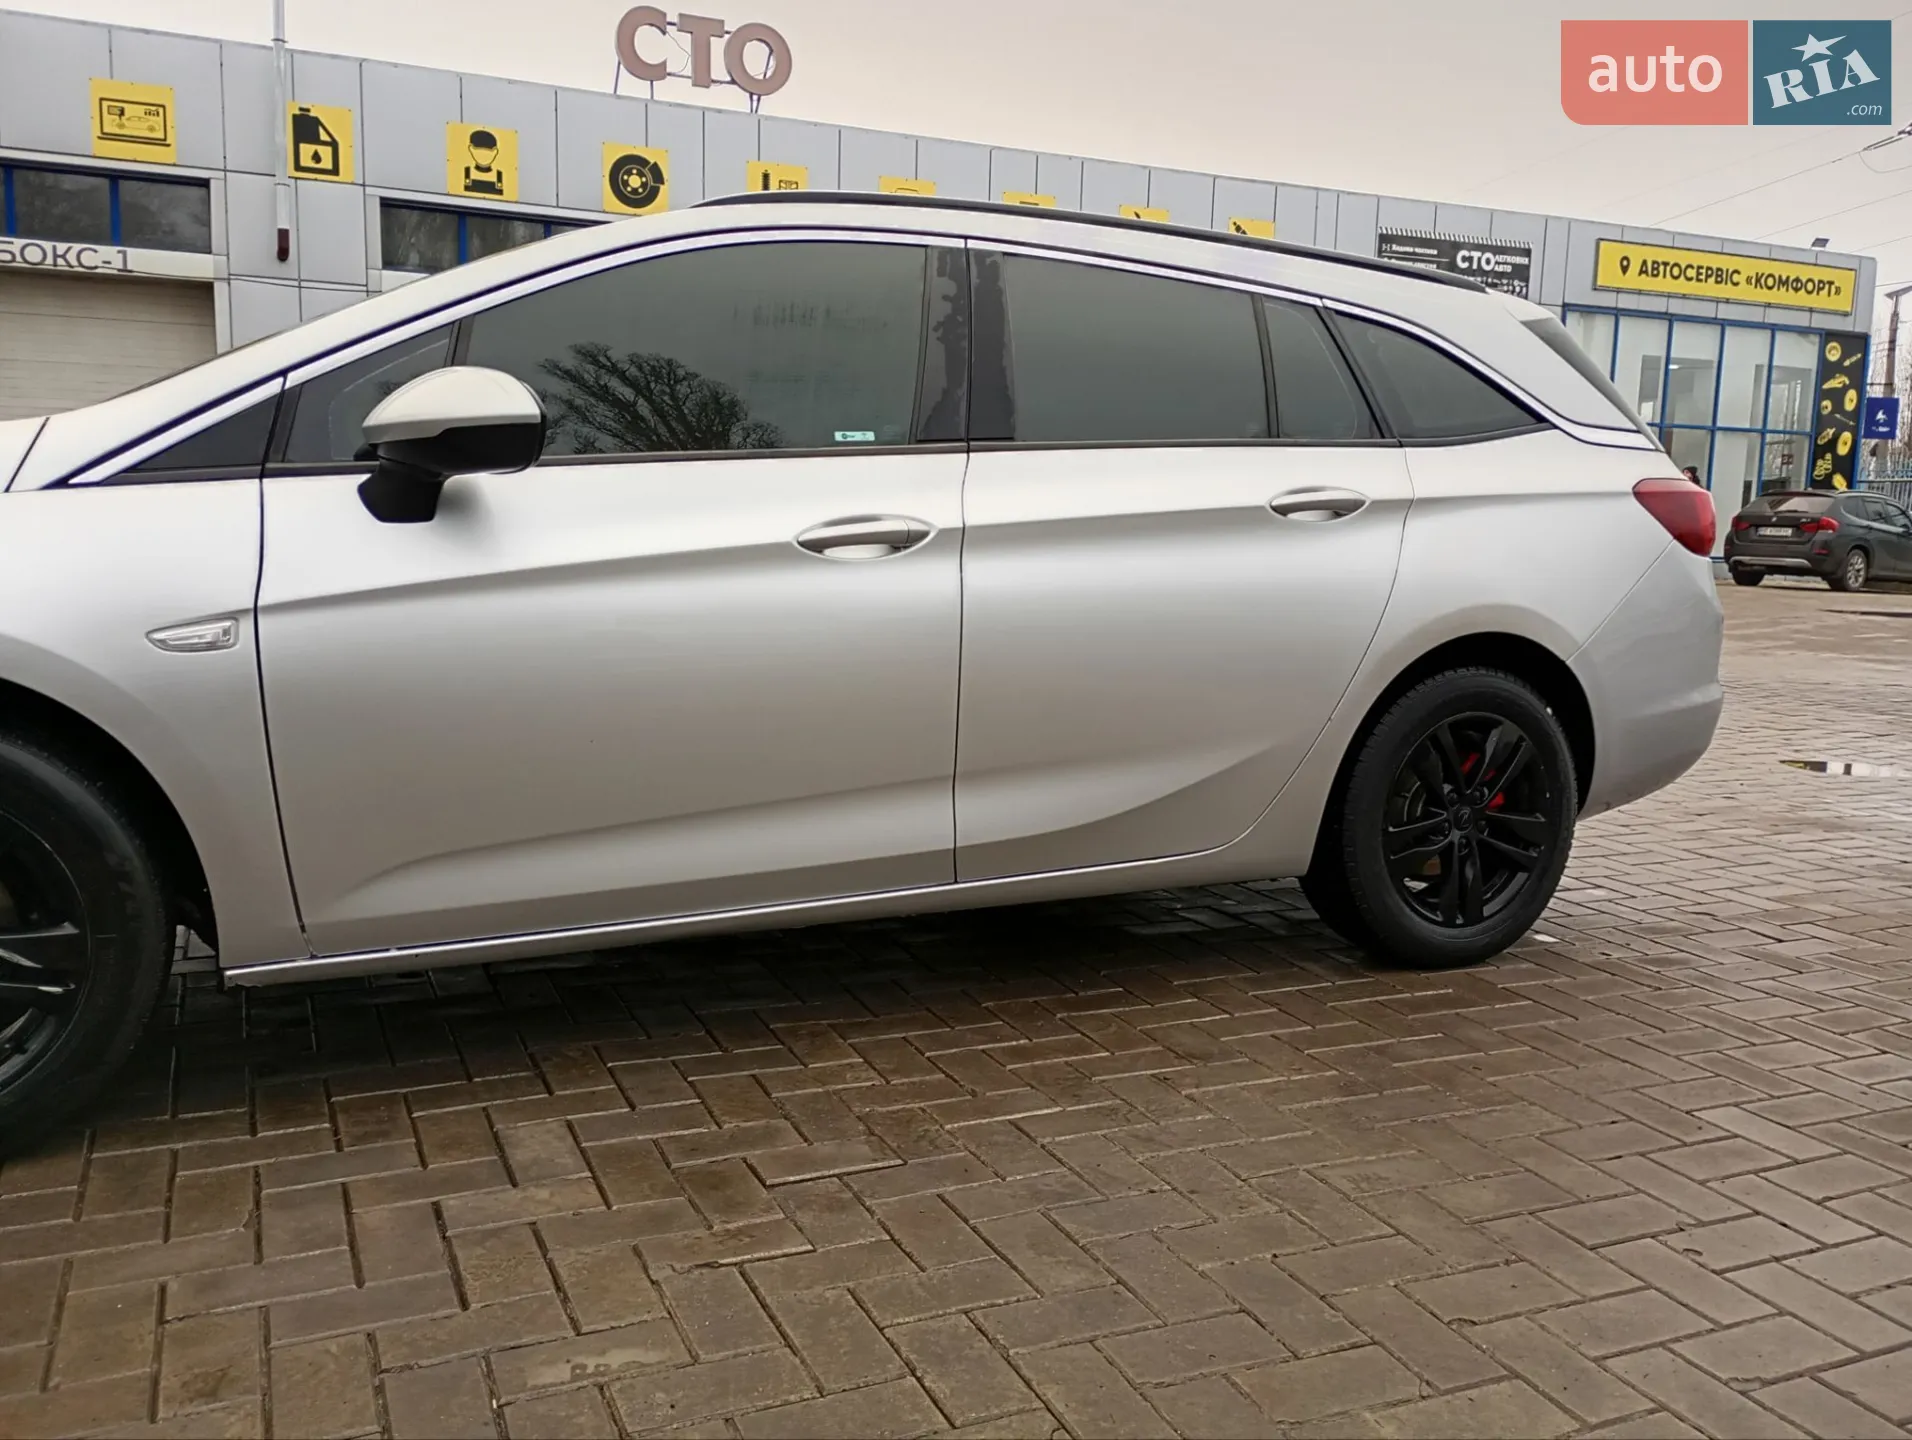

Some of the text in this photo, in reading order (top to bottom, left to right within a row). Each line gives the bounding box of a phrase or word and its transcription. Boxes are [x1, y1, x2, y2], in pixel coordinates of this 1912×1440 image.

[615, 5, 792, 96] СТО
[0, 240, 133, 273] БОКС-1
[1456, 249, 1495, 271] СТО
[1637, 259, 1842, 297] АВТОСЕРВІС «КОМФОРТ»
